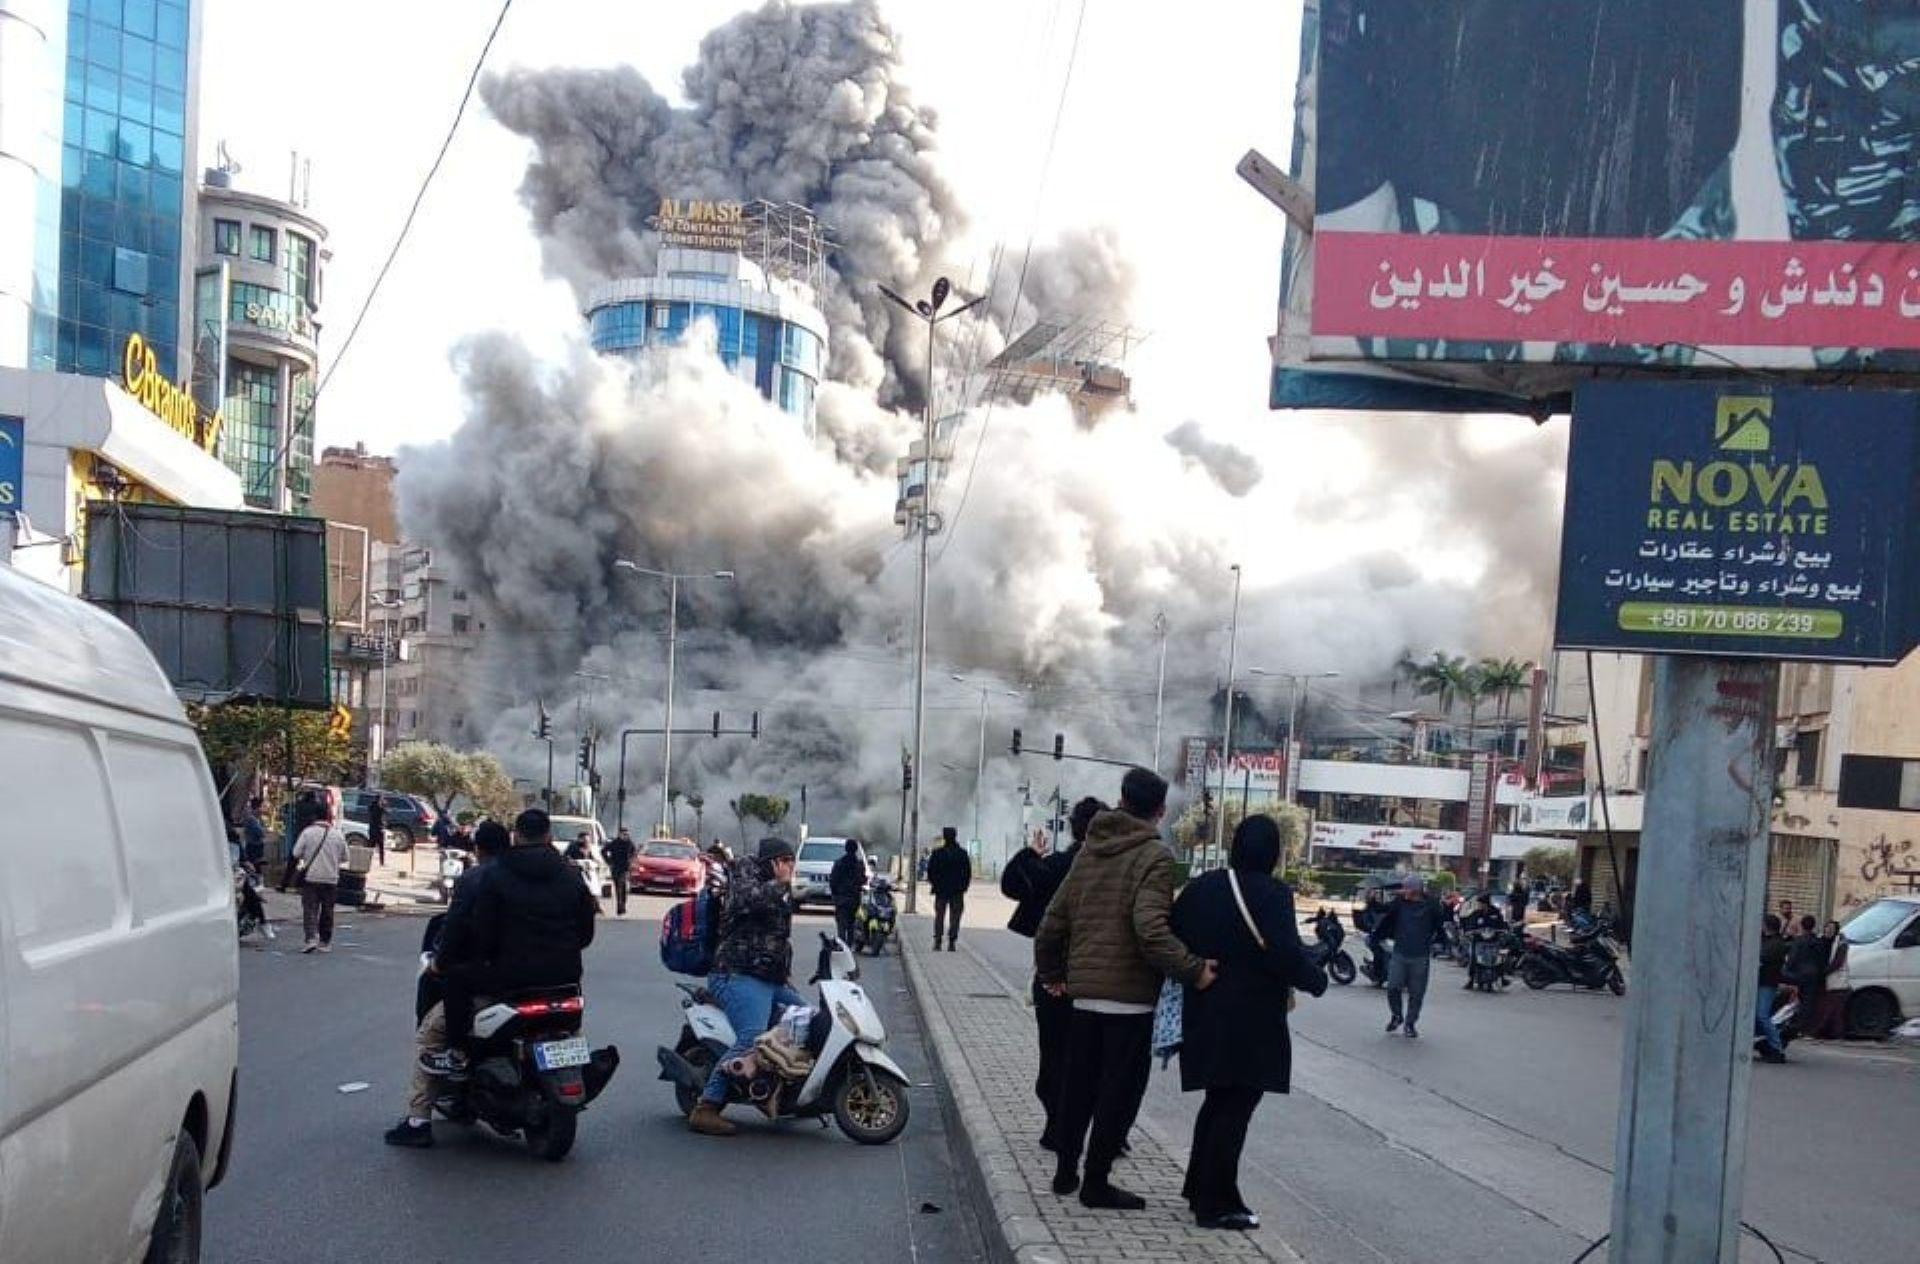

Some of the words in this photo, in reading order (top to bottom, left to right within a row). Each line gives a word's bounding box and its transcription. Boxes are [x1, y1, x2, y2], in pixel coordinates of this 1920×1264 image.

[1370, 258, 1485, 309] الدين
[1497, 257, 1566, 315] خير
[1582, 262, 1709, 315] حسين
[1719, 276, 1745, 315] و
[1760, 257, 1884, 318] دندش
[1650, 460, 1829, 508] NOVA
[1648, 508, 1714, 531] REAL
[1729, 512, 1828, 534] ESTATE
[1639, 541, 1714, 561] عقارات
[1721, 541, 1787, 566] وشراء
[1793, 551, 1832, 568] بيع
[1605, 569, 1674, 592] سيارات
[1679, 571, 1749, 595] وتأجير
[1757, 573, 1819, 598] وشراء
[1825, 583, 1861, 600] بيع
[1648, 608, 1697, 627] +961
[1703, 608, 1727, 629] 70
[1733, 612, 1768, 630] 086
[1775, 613, 1813, 632] 239
